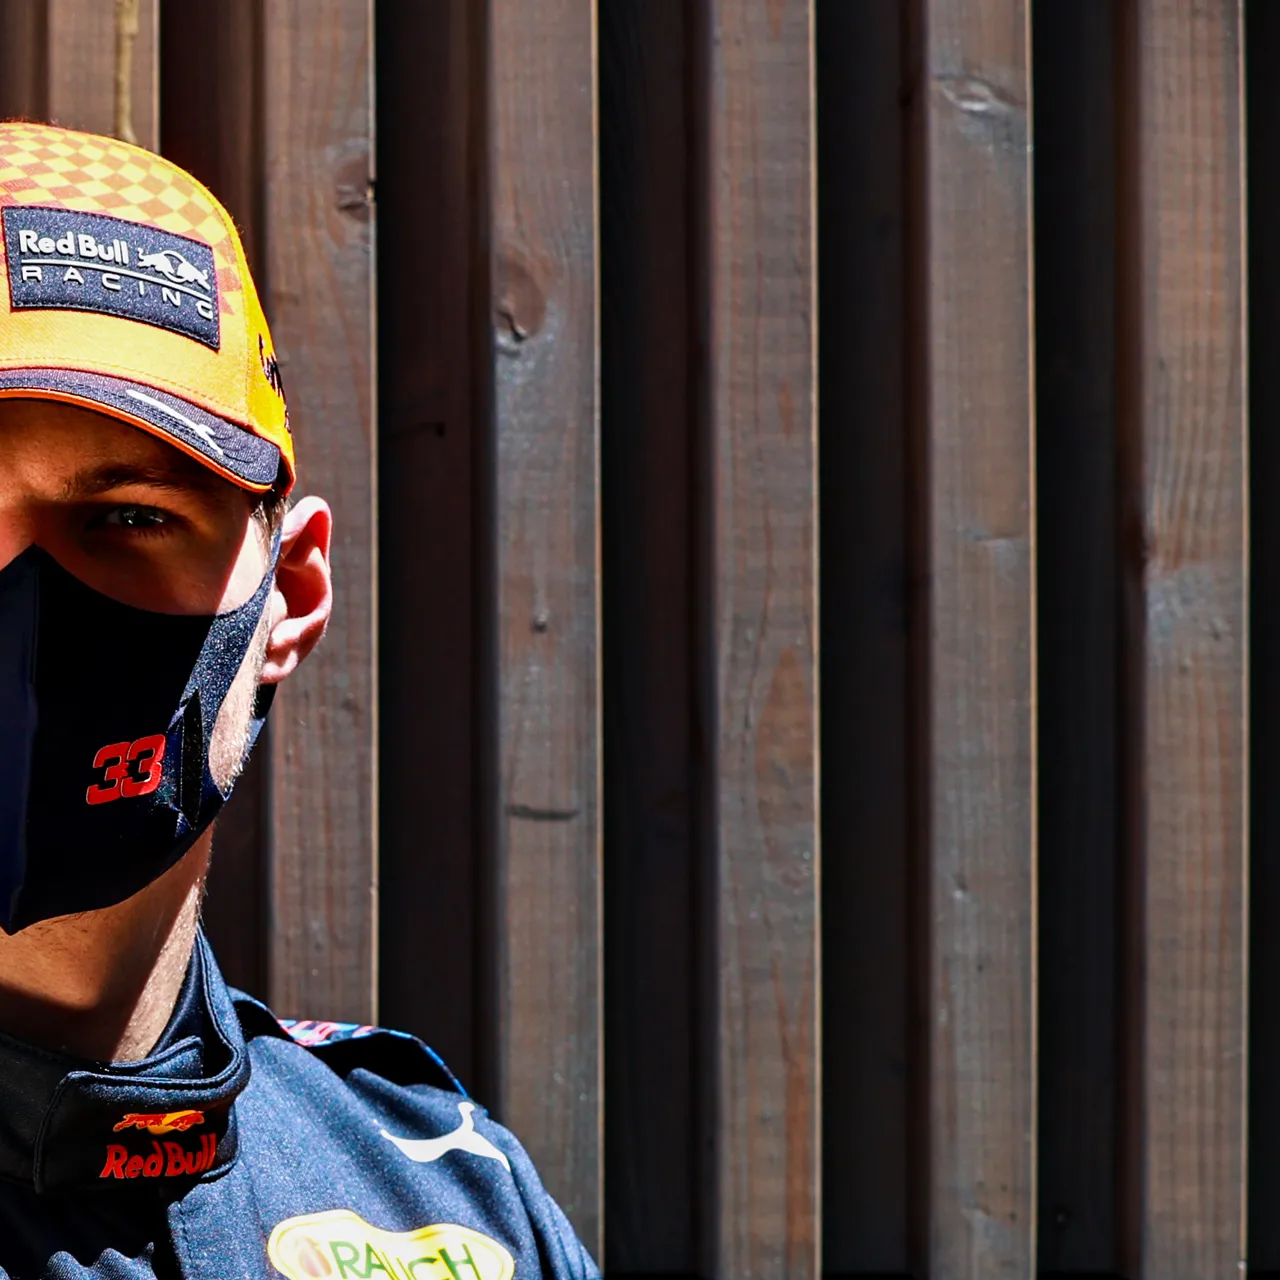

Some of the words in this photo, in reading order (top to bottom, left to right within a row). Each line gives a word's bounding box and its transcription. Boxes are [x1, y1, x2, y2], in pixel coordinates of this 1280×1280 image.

[19, 230, 74, 255] Red
[78, 234, 129, 264] Bull
[21, 266, 213, 319] RACING
[85, 733, 166, 805] 33
[99, 1140, 163, 1179] Red
[162, 1133, 216, 1177] Bull
